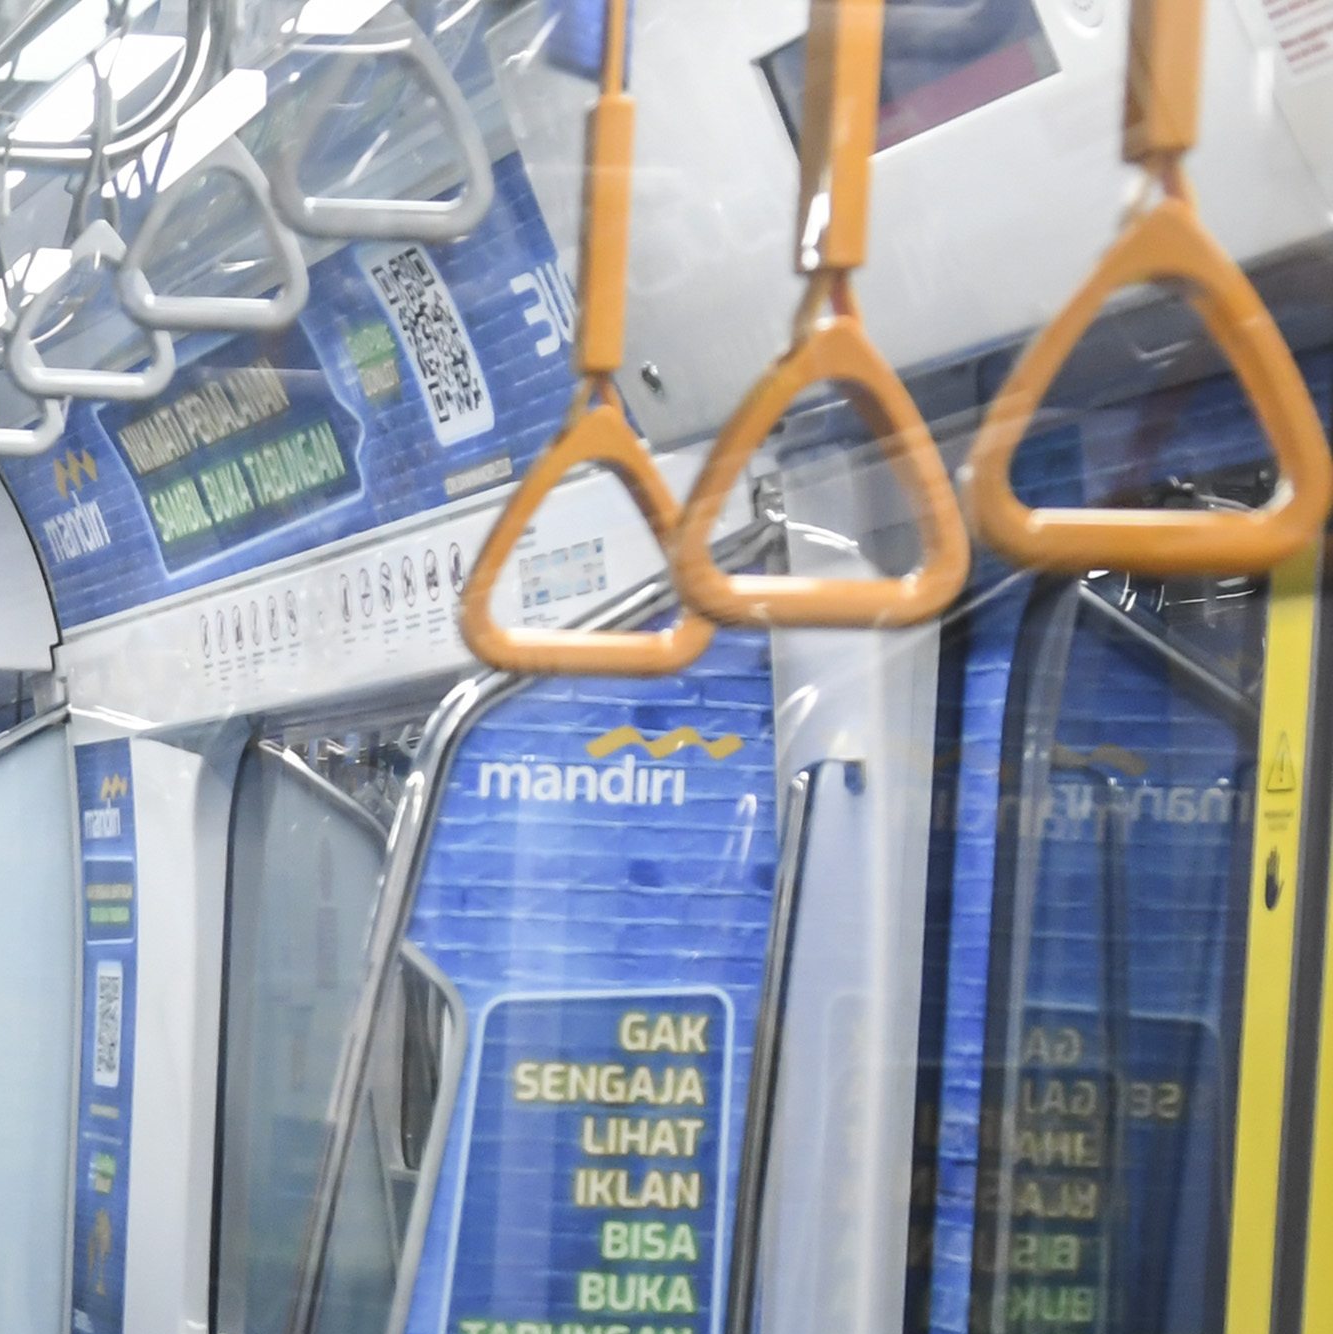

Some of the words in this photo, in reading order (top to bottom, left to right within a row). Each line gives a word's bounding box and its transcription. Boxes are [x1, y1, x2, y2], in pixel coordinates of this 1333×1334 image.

[478, 755, 686, 806] mandiri
[621, 1014, 708, 1053] GAK
[515, 1062, 706, 1105] SENGAJA
[583, 1116, 704, 1157] LIHAT
[574, 1168, 701, 1209] IKLAN
[602, 1221, 697, 1261] BISA
[579, 1272, 695, 1313] BUKA
